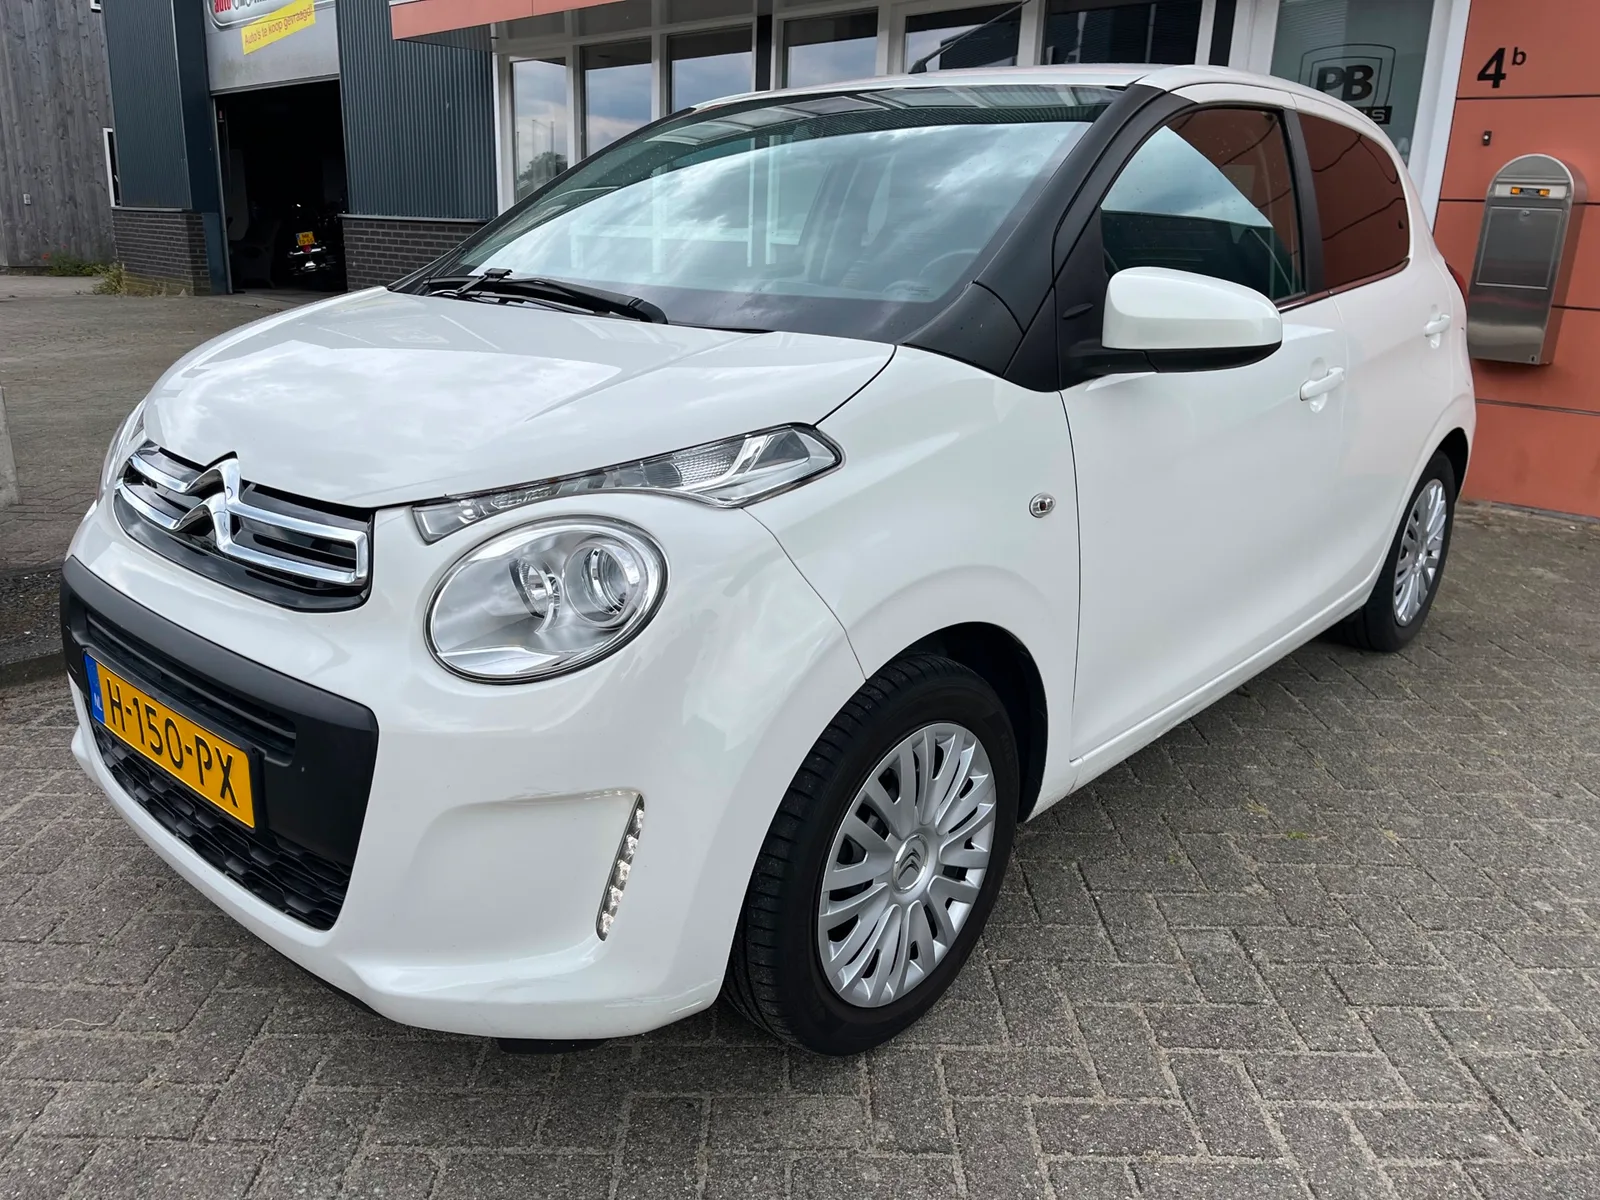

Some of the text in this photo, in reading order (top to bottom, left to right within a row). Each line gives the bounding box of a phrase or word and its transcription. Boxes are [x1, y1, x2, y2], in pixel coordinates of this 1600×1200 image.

[261, 26, 268, 38] te
[268, 20, 283, 35] koop
[1316, 64, 1374, 101] PB
[93, 692, 103, 711] NL
[106, 677, 239, 808] H-150-PX
